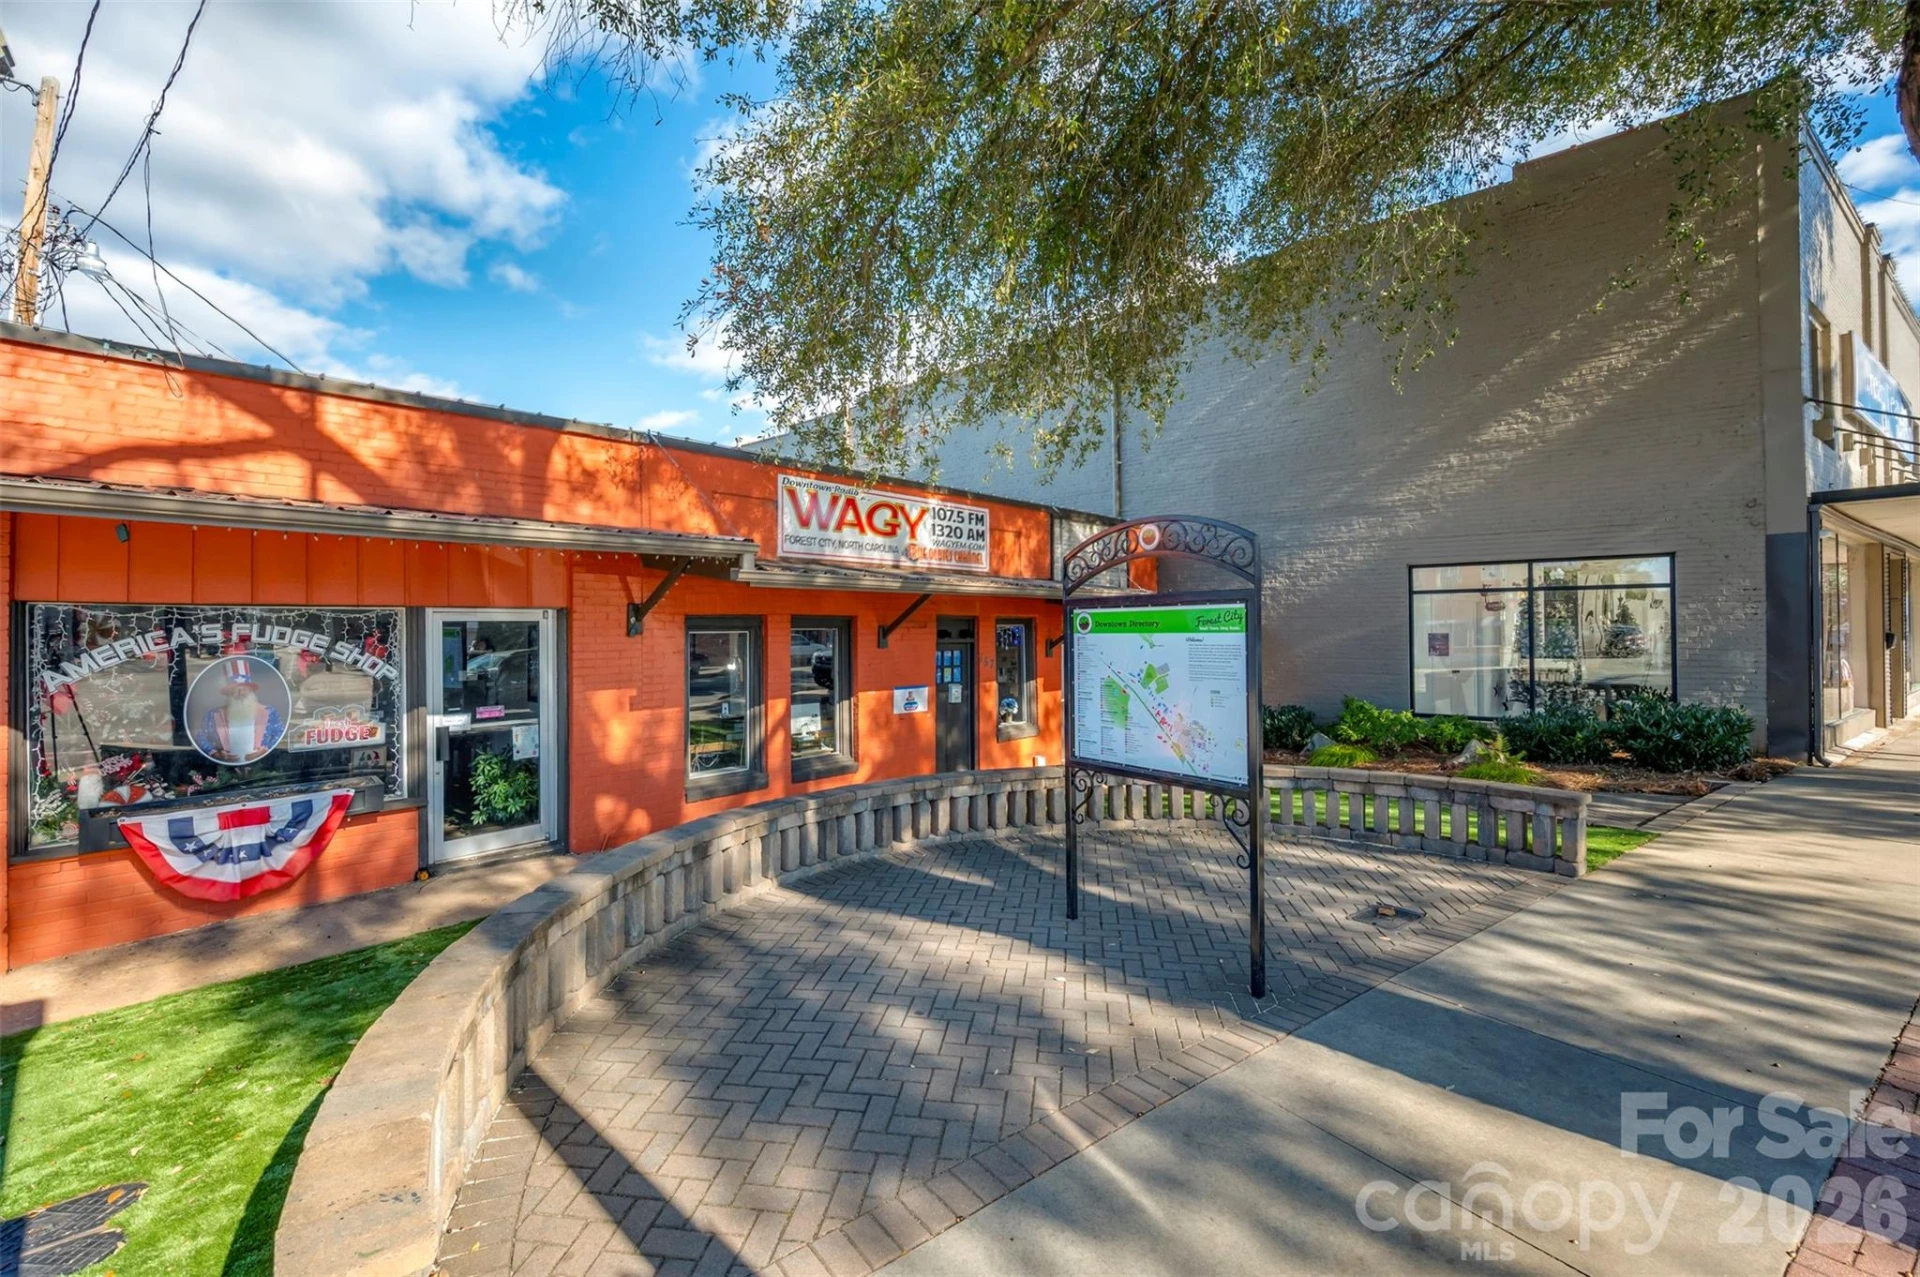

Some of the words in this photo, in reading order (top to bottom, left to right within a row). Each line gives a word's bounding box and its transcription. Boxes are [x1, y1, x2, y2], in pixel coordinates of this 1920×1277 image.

[781, 476, 834, 492] Downtown
[834, 486, 860, 497] Radio
[783, 485, 930, 542] WAGY
[931, 507, 964, 525] 107.5
[967, 512, 985, 528] FM
[930, 523, 963, 540] 1320
[966, 528, 986, 542] AM
[784, 533, 818, 547] FOREST
[818, 537, 838, 550] CITY,
[838, 539, 864, 551] NORTH
[864, 542, 900, 554] CAROLINA
[931, 540, 985, 551] WAGYFM.COM
[1095, 620, 1127, 628] Downtown
[1129, 619, 1160, 629] Directory
[1195, 613, 1221, 628] Forest
[1223, 609, 1243, 625] City
[41, 623, 223, 695] AMERICA'S
[231, 623, 331, 655] FUDGE
[330, 640, 399, 681] SHOP
[304, 724, 371, 745] FUDGE
